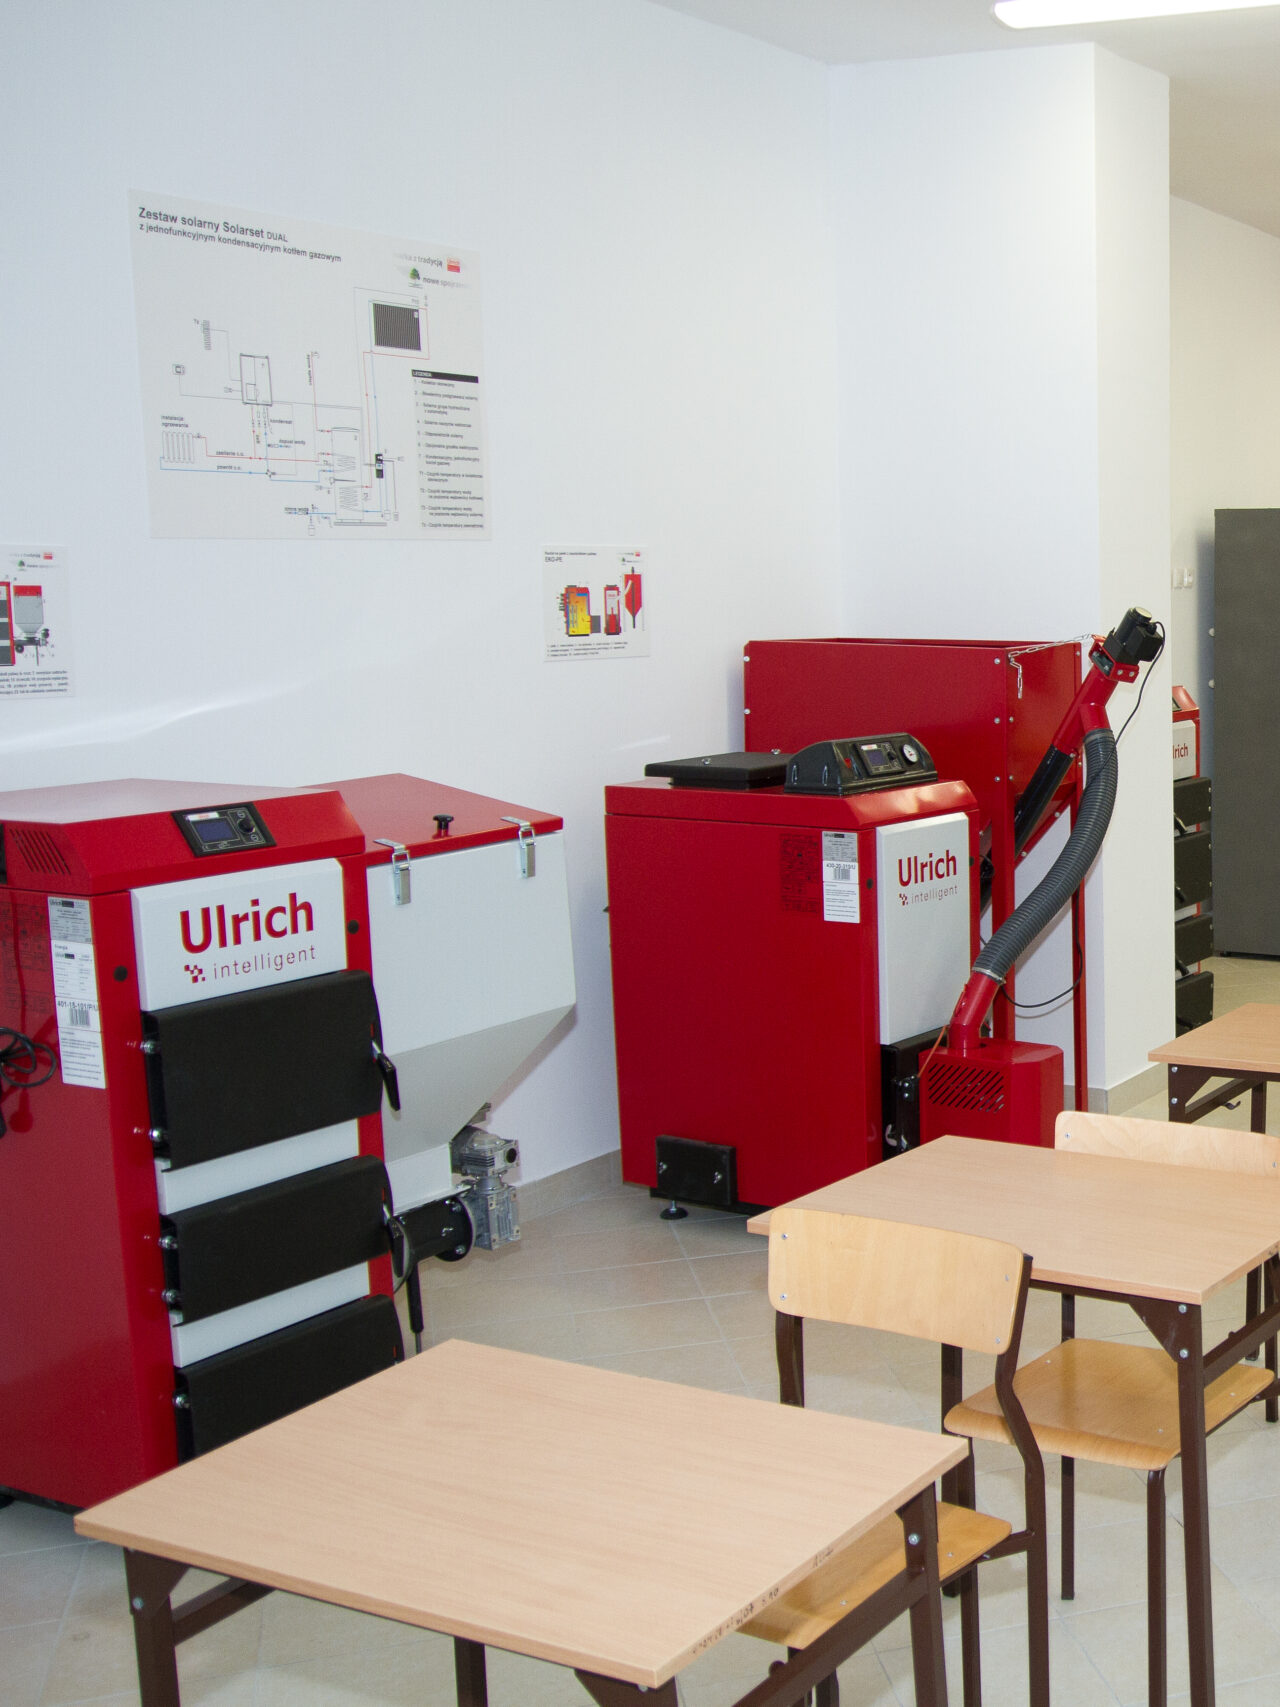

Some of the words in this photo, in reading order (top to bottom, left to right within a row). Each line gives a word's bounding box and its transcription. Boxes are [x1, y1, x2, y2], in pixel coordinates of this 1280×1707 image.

[138, 207, 178, 224] Zestaw
[181, 215, 219, 232] solarny
[222, 221, 265, 239] Solarset
[266, 231, 288, 242] DUAL
[146, 223, 216, 242] jednofunkcyjnym
[218, 234, 282, 253] kondensacyjnym
[308, 250, 342, 262] gazowym
[1173, 743, 1189, 759] lrich
[898, 849, 957, 887] Ulrich
[911, 885, 958, 904] intelligent
[179, 892, 314, 954] Ulrich
[213, 945, 316, 980] intelligent
